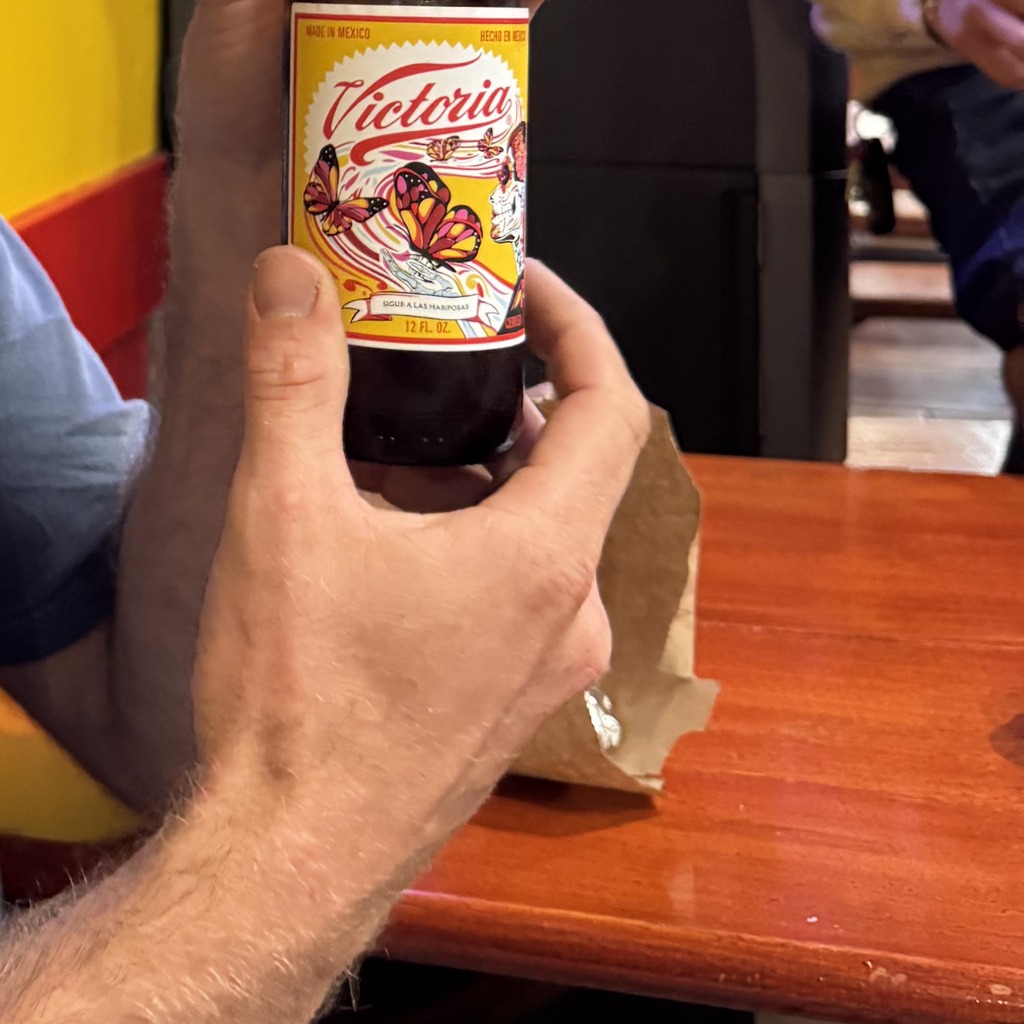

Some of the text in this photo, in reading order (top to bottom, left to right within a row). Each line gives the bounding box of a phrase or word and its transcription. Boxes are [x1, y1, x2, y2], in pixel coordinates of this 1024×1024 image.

[306, 25, 371, 40] MADE IN MEXICO
[480, 30, 502, 42] HECHO
[504, 30, 511, 42] EN
[323, 52, 512, 142] Victoria
[382, 300, 405, 308] SIGUE
[413, 301, 428, 310] LAS
[429, 303, 470, 311] MARIPOSAS
[405, 320, 451, 334] 12 FL. OZ.
